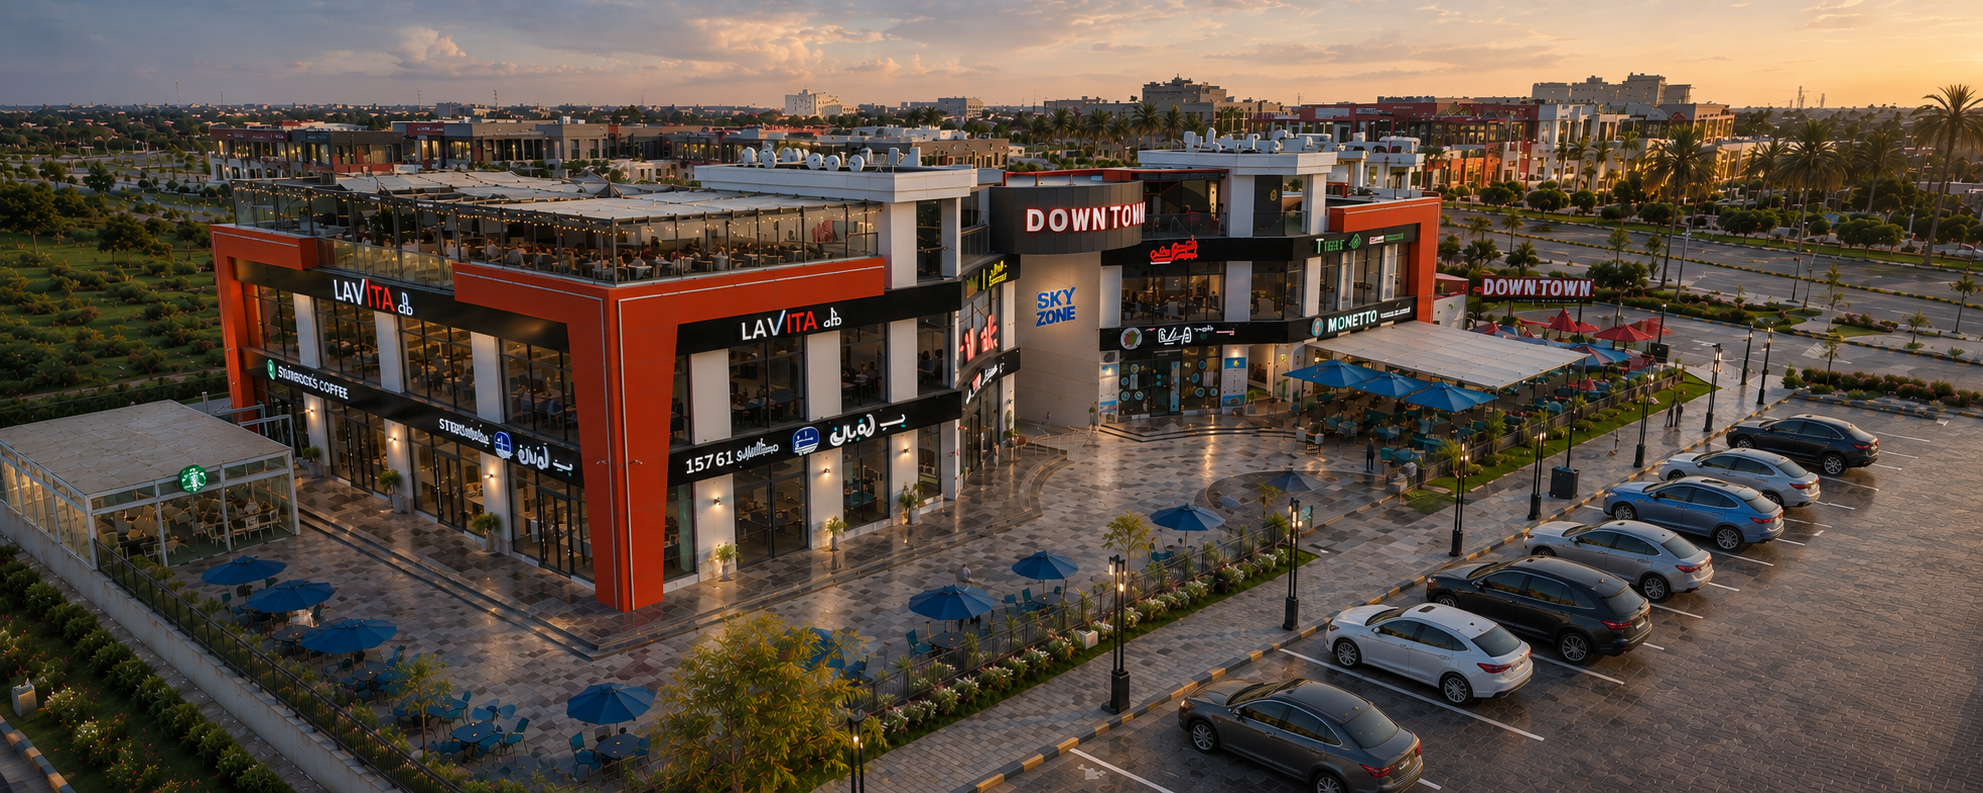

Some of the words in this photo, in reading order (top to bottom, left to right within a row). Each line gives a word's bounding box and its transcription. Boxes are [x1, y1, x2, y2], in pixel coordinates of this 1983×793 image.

[333, 278, 396, 312] LAVITA
[1037, 286, 1076, 309] SKY
[741, 309, 818, 340] LAVITA
[1036, 305, 1076, 327] ZONE
[1327, 309, 1377, 333] MONETTO
[319, 380, 349, 400] COFFEE
[686, 451, 734, 474] 15761
